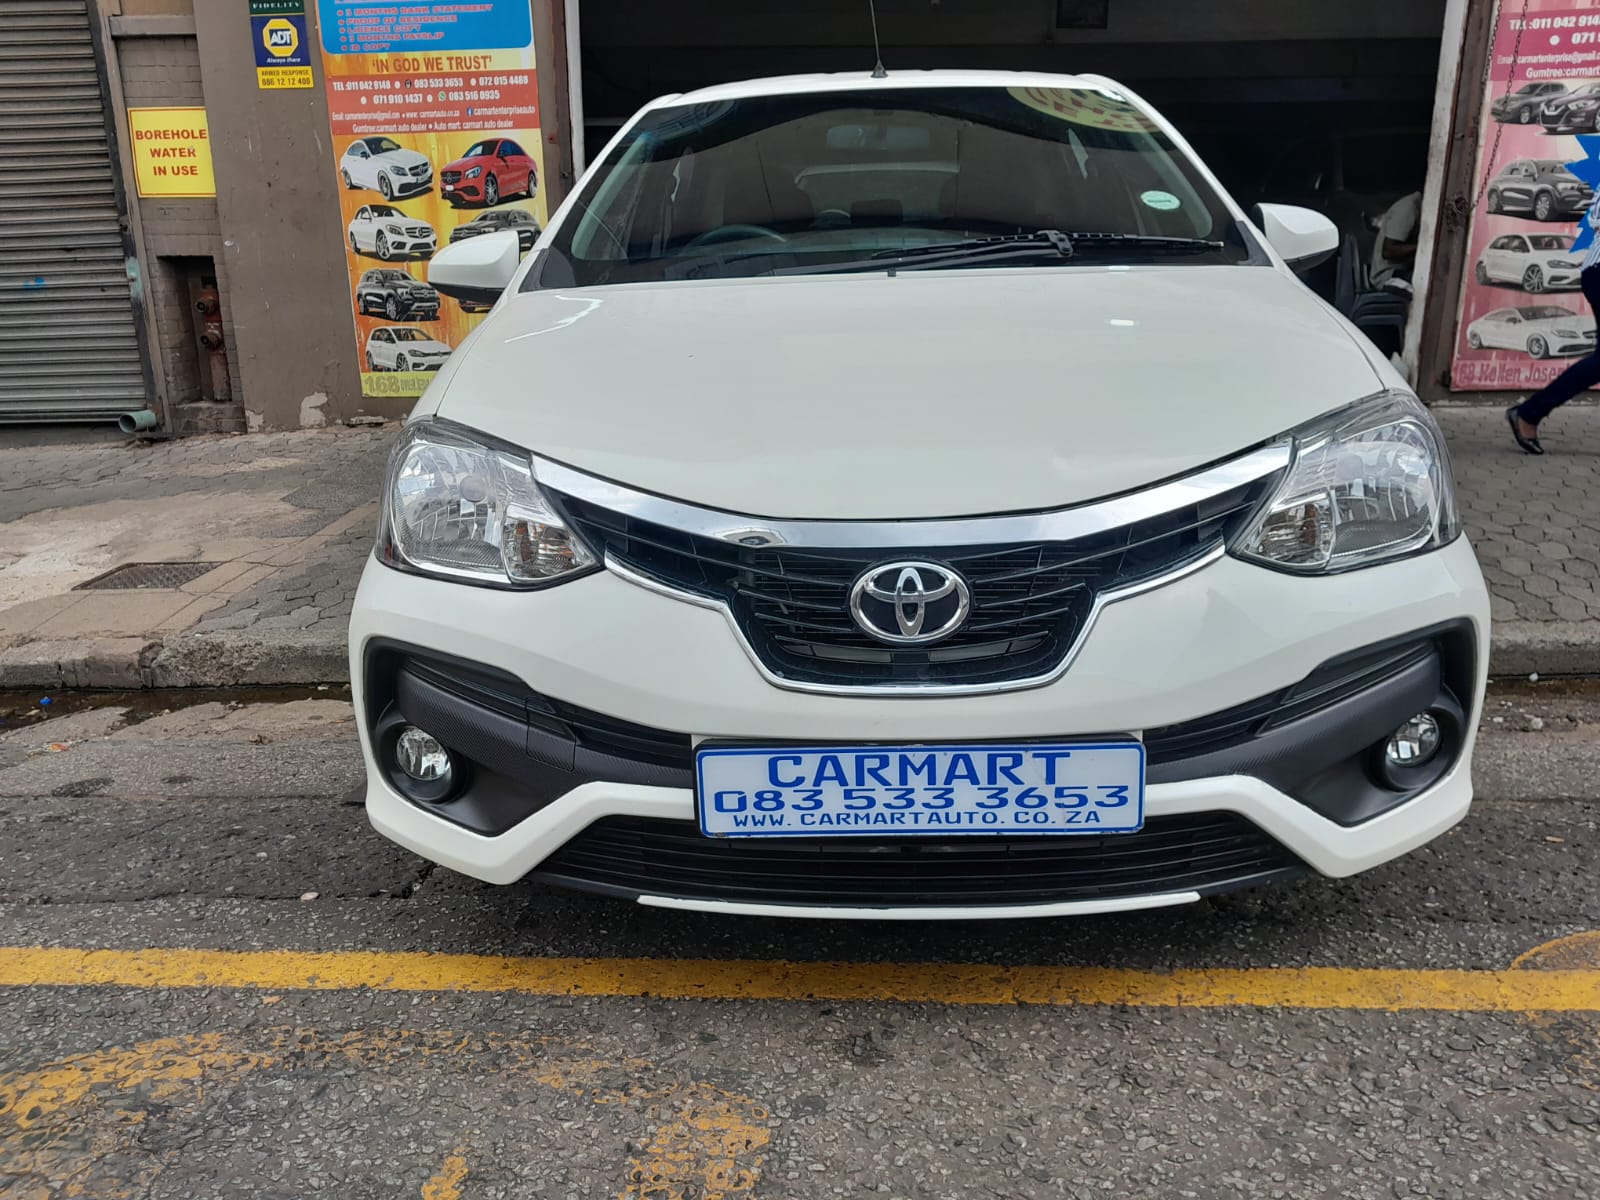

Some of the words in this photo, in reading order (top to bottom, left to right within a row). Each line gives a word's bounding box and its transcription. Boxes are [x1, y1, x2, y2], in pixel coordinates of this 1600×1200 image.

[400, 6, 429, 14] BANK
[432, 4, 494, 13] STATEMENT
[347, 17, 380, 25] PROOF
[384, 16, 396, 24] OF
[399, 14, 458, 24] RESIDENCE
[1553, 16, 1576, 28] 042
[1578, 15, 1600, 27] 914
[393, 24, 421, 32] COPY
[271, 31, 292, 45] ADT
[357, 33, 401, 41] MONTHS
[403, 32, 446, 40] PAYSLIP
[1571, 32, 1595, 44] 071
[362, 43, 390, 51] COPY
[393, 57, 420, 72] GOD
[423, 56, 443, 72] WE
[277, 77, 285, 85] 12
[287, 77, 295, 85] 12
[298, 77, 310, 85] 400
[360, 80, 373, 90] 042
[479, 76, 493, 86] 072
[494, 75, 508, 85] 015
[373, 94, 387, 105] 071
[448, 91, 463, 101] 083
[411, 123, 427, 132] dealer
[433, 121, 447, 130] Auto
[497, 118, 513, 128] dealer
[135, 129, 207, 140] BOREHOLE
[150, 147, 196, 158] WATER
[153, 165, 167, 176] IN
[171, 165, 198, 176] USE
[364, 375, 400, 394] 168
[768, 752, 1071, 788] CARMART
[714, 789, 824, 813] 083
[843, 788, 955, 810] 533
[975, 785, 1129, 809] 3653
